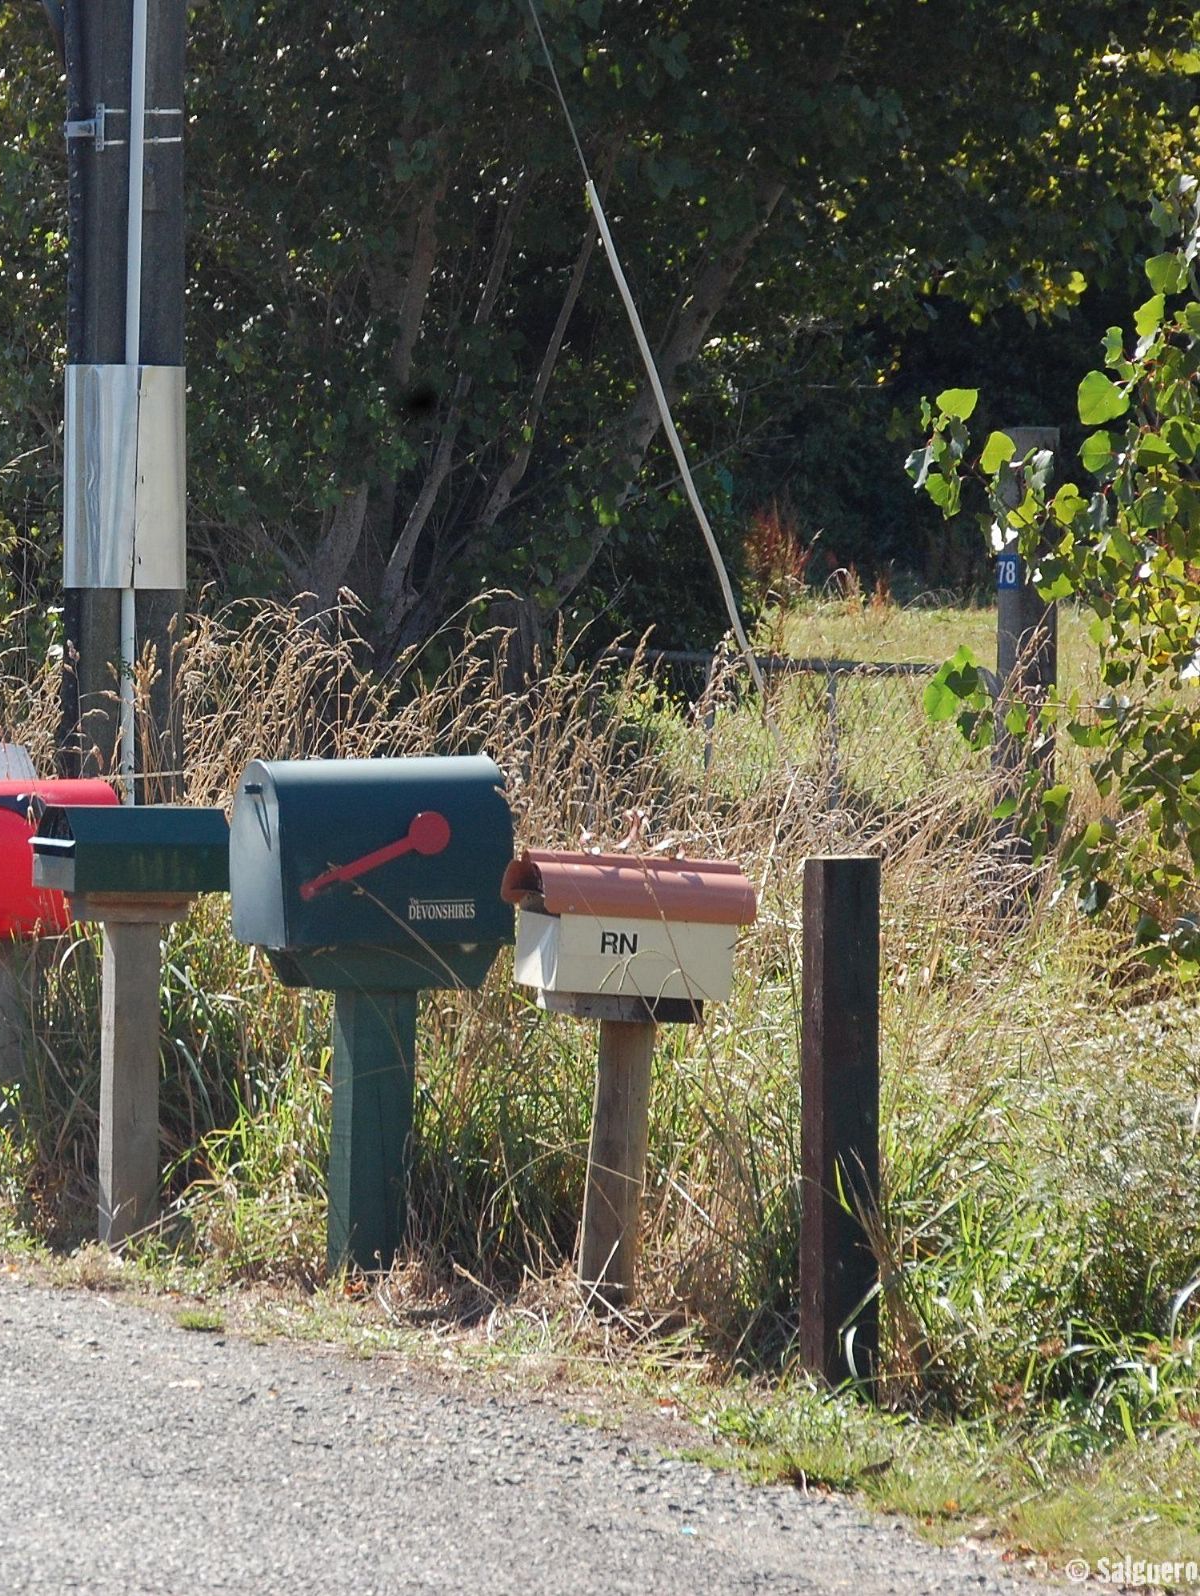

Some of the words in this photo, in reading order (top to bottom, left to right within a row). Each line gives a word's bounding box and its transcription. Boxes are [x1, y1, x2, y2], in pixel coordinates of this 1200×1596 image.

[998, 561, 1016, 584] 78
[408, 903, 476, 920] DEVONSHIRES
[600, 931, 638, 955] RN
